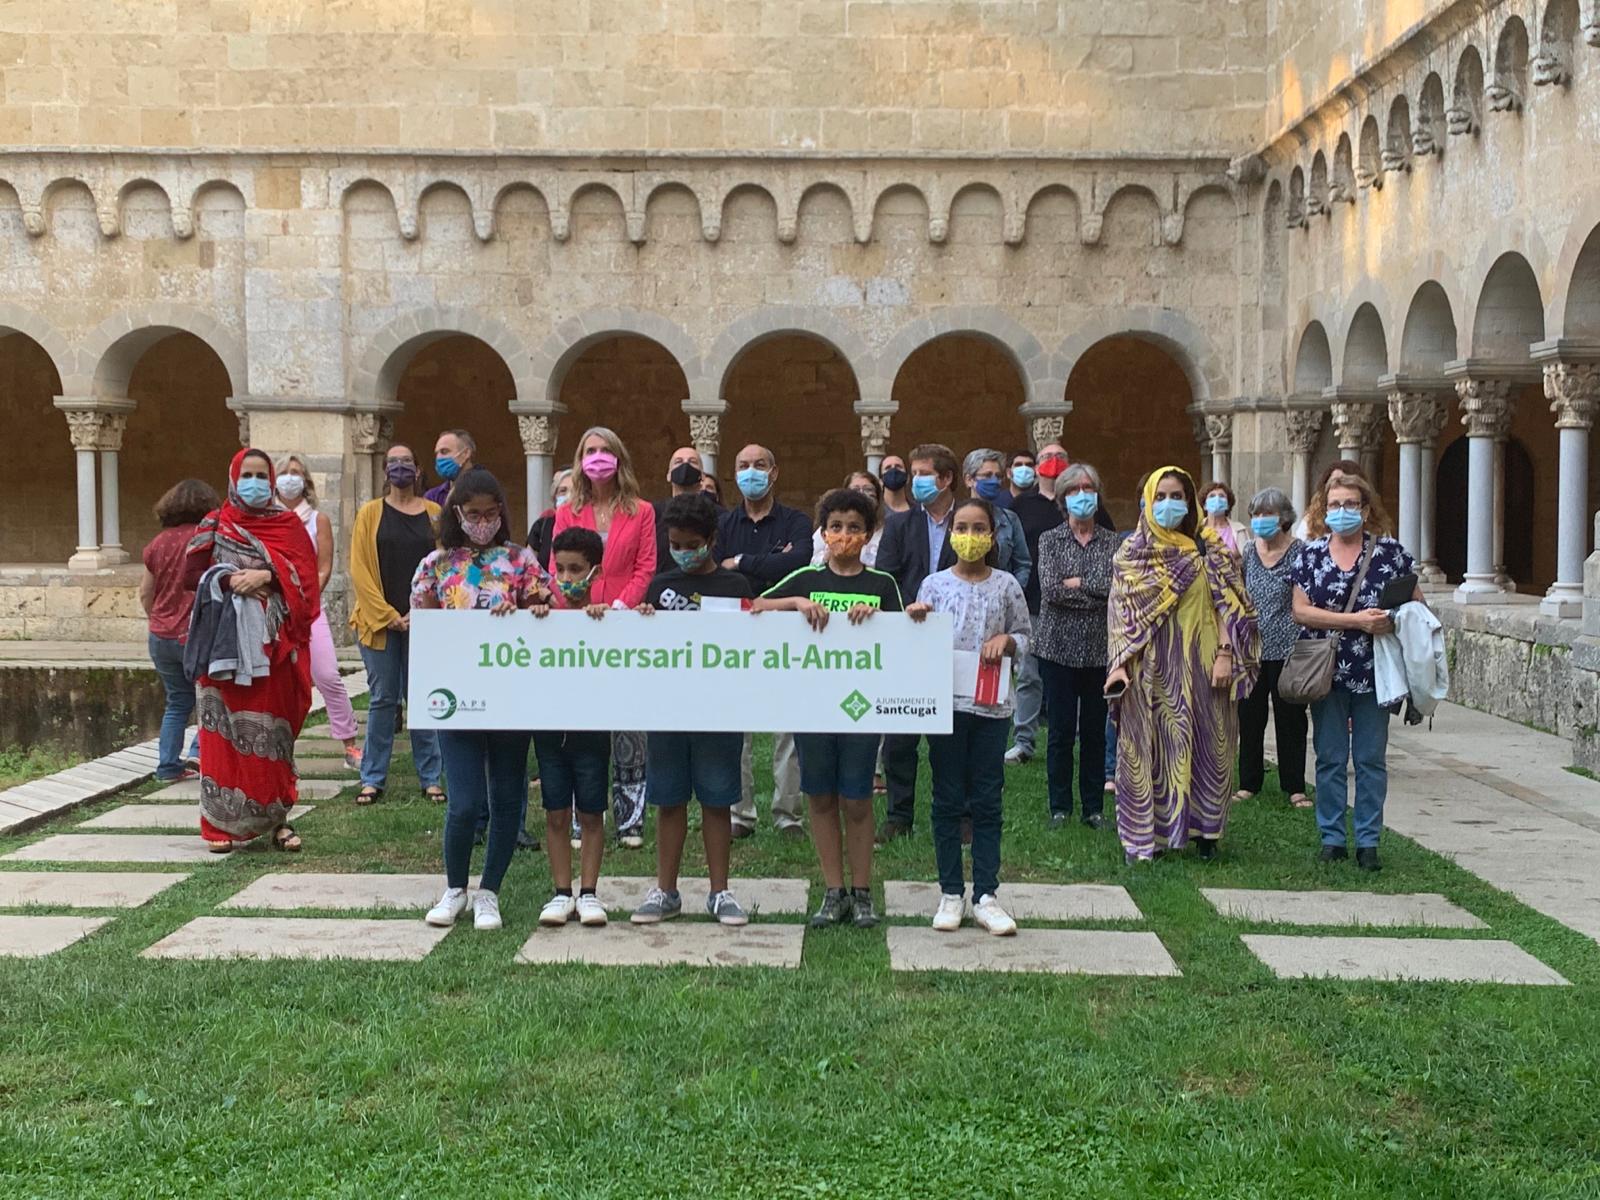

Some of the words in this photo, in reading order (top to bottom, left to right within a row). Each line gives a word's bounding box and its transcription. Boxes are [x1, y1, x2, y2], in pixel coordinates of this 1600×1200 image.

[478, 636, 531, 667] 10è
[539, 640, 693, 668] aniversari
[702, 643, 755, 669] Dar
[763, 642, 882, 670] al-Amal
[927, 697, 936, 705] DE
[875, 704, 936, 717] SantCugat
